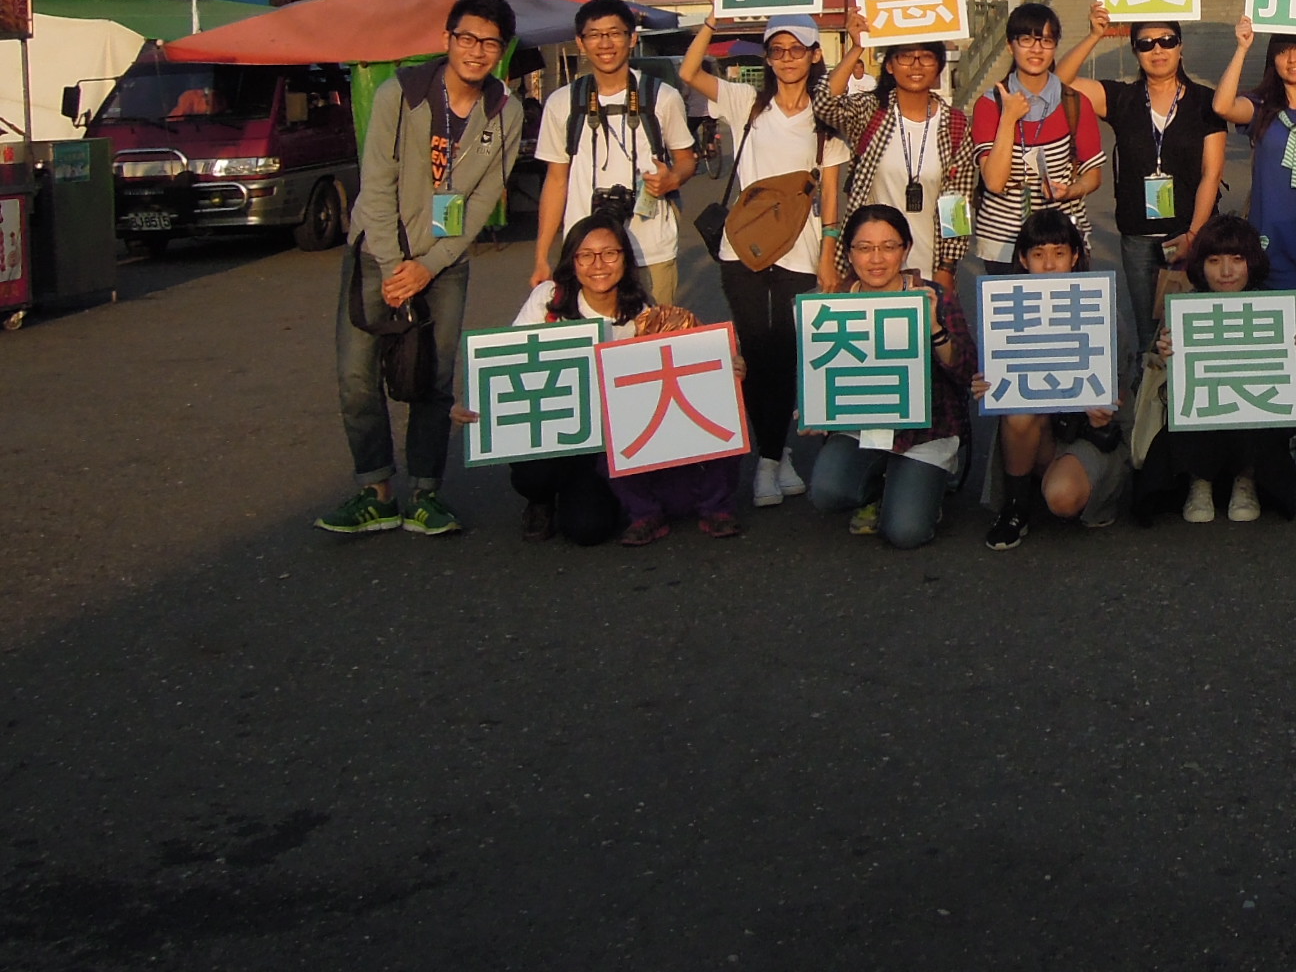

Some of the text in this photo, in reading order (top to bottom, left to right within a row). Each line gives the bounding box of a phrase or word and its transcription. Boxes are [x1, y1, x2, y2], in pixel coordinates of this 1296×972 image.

[473, 334, 594, 454] 南
[810, 304, 919, 422] 智
[990, 283, 1105, 402] 慧
[1180, 302, 1294, 419] 農
[612, 344, 736, 460] 大
